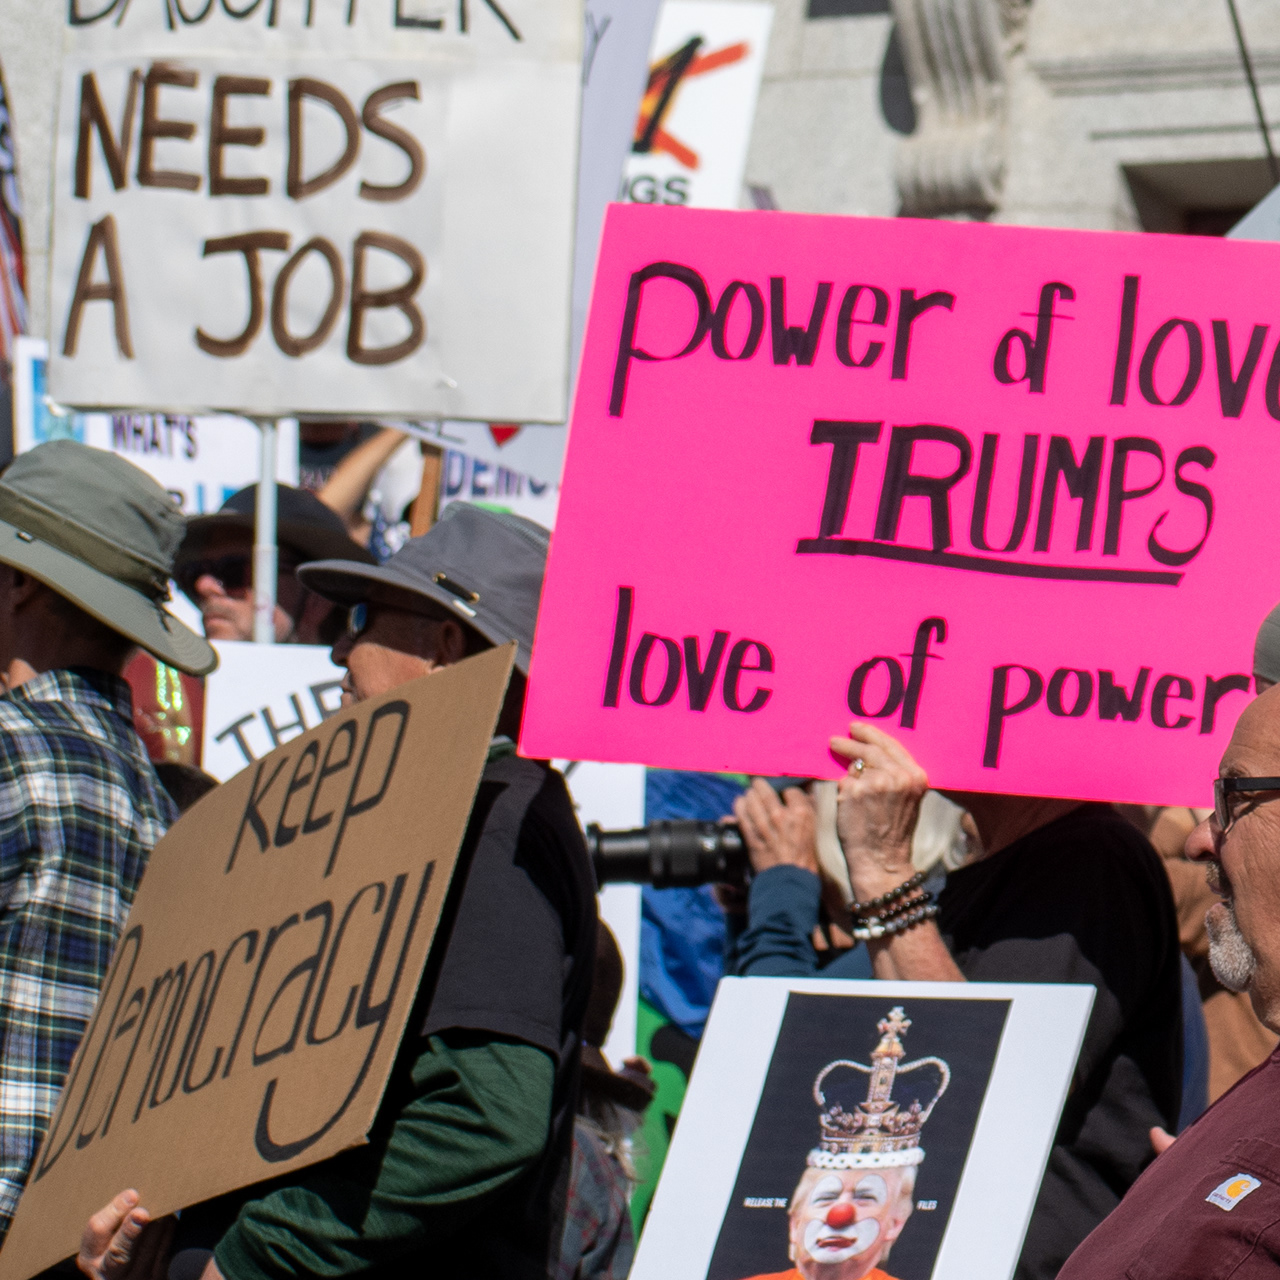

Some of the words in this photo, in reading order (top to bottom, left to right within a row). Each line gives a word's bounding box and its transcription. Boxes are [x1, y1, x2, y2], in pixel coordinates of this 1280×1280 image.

[74, 61, 427, 201] NEEDS
[62, 215, 135, 359] A
[194, 229, 425, 366] JOB
[609, 261, 955, 417] power
[992, 282, 1075, 394] of
[808, 419, 1217, 567] TRUMPS
[603, 586, 775, 712] love
[847, 616, 947, 728] of
[983, 664, 1252, 769] power
